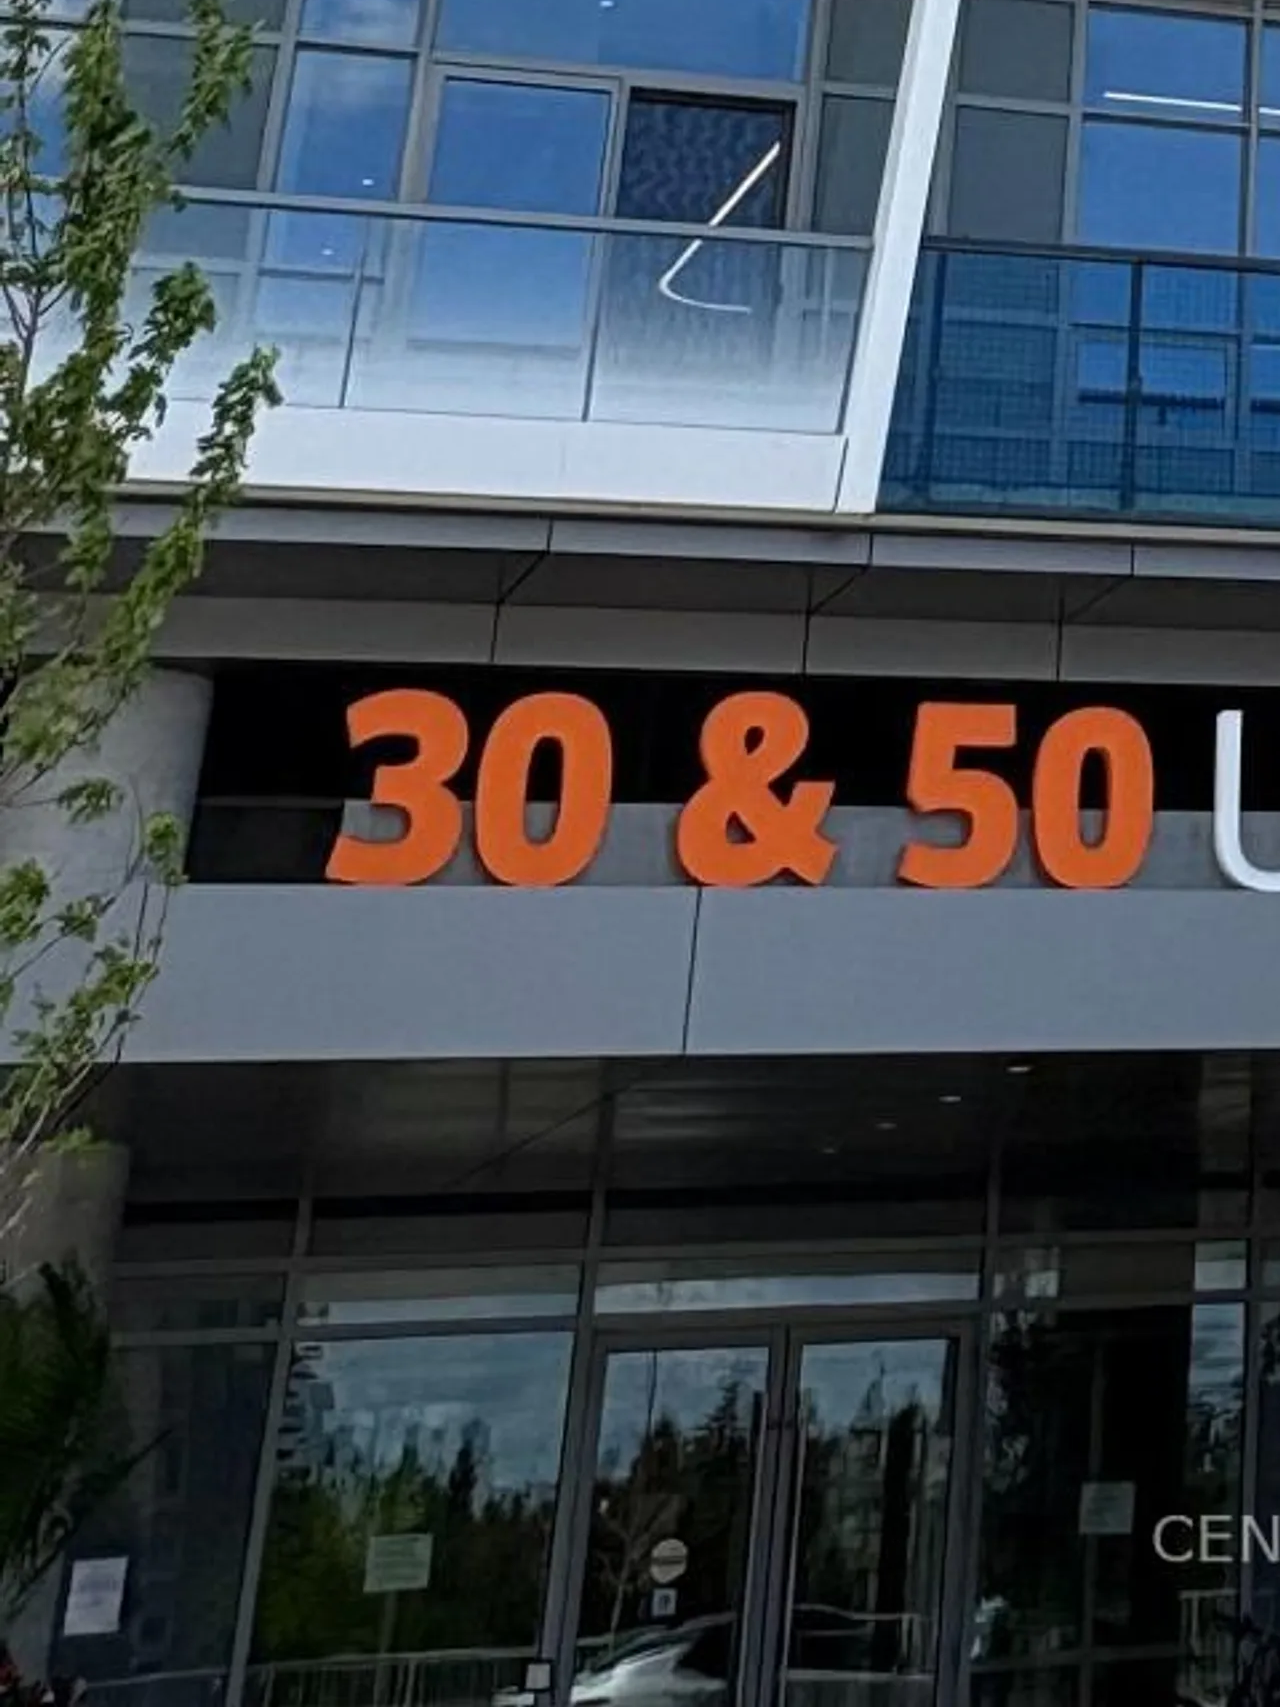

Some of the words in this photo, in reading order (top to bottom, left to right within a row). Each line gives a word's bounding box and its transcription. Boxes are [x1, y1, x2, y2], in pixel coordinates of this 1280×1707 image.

[325, 688, 613, 888] 30
[676, 690, 837, 888] &
[897, 702, 1154, 890] 50
